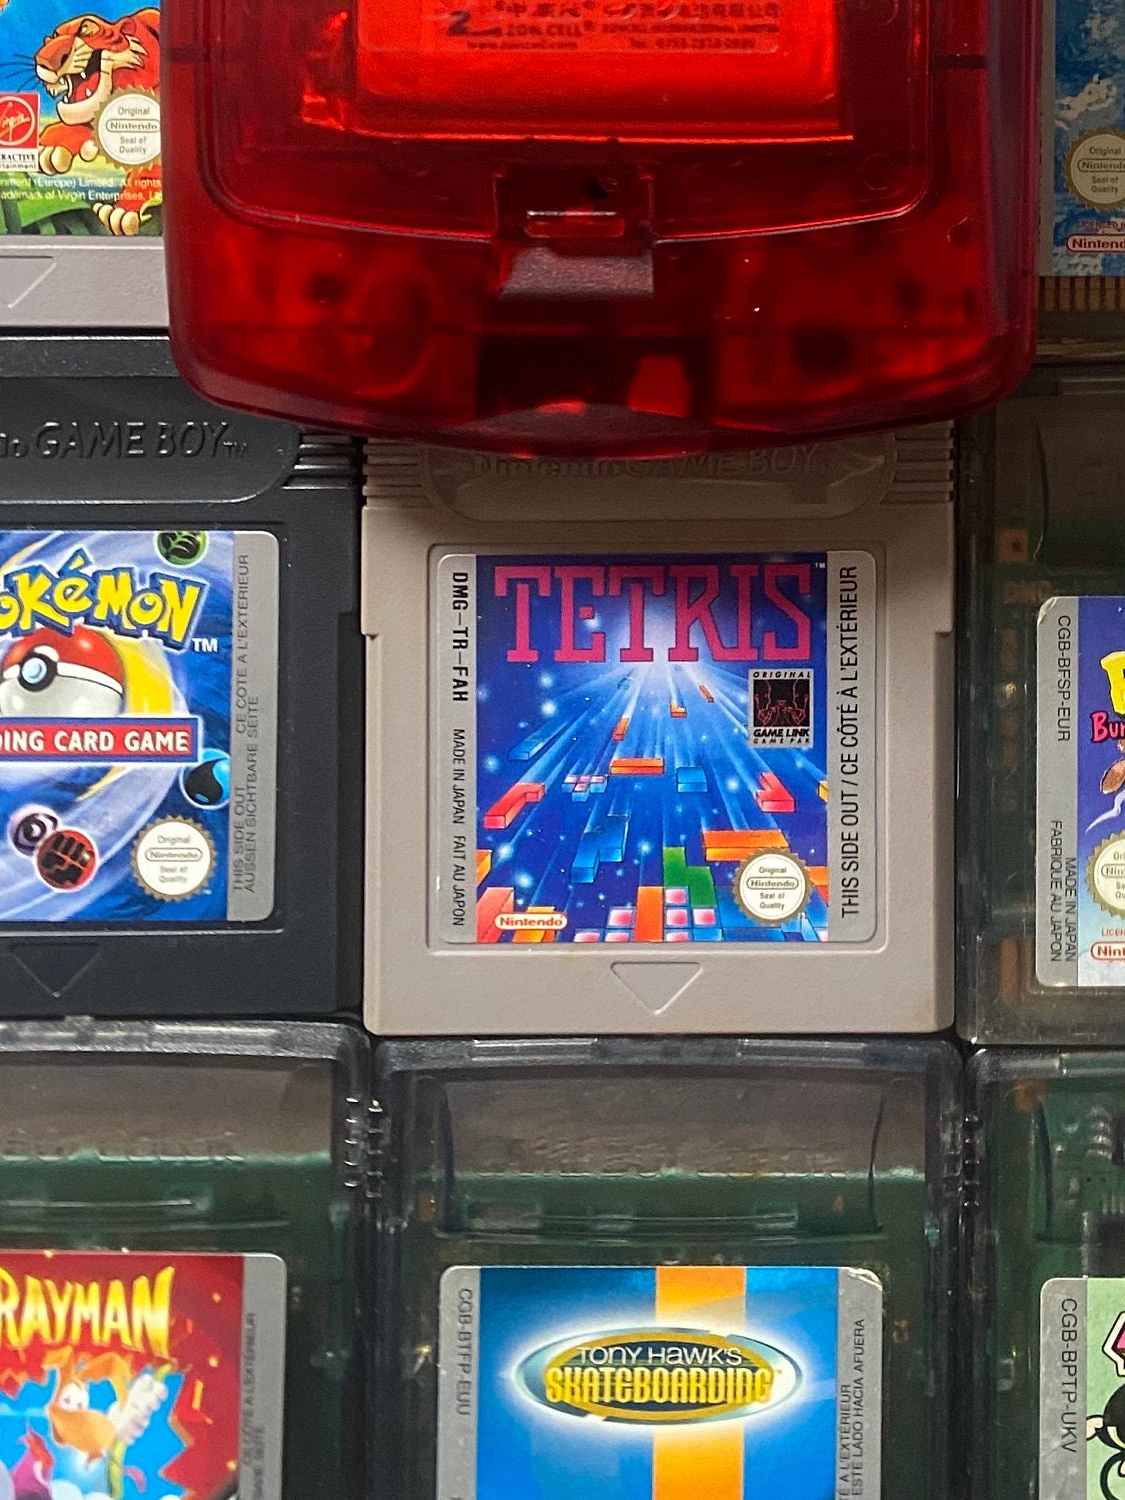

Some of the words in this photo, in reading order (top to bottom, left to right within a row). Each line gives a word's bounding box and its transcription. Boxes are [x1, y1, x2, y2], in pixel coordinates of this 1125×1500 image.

[110, 122, 158, 131] Nintendo
[118, 106, 150, 117] Original
[1089, 146, 1122, 157] Original
[36, 421, 144, 458] GAME
[155, 421, 229, 458] BOY
[494, 565, 812, 663] TETRIS
[839, 565, 859, 682] L'EXTÉRIEUR
[753, 671, 811, 679] ORIGINAL
[1057, 615, 1071, 742] CGB-BFSP-EUR
[54, 730, 114, 752] CARD
[124, 730, 190, 753] GAME
[753, 728, 782, 738] GAME
[783, 728, 811, 738] LINK
[836, 705, 859, 747] CÔTÉ
[453, 728, 466, 765] MADE
[840, 752, 859, 776] CE
[453, 769, 466, 781] IN
[453, 785, 465, 825] JAPAN
[840, 789, 860, 827] OUT
[148, 850, 201, 861] Nintendo
[157, 834, 191, 846] Original
[453, 835, 466, 861] FAIT
[840, 831, 860, 873] SIDE
[1050, 820, 1063, 890] FABRIQUE
[453, 864, 466, 882] AU
[749, 878, 797, 889] Nintendo
[758, 865, 788, 875] Original
[1065, 857, 1077, 897] MADE
[453, 884, 466, 926] JAPON
[840, 875, 860, 920] THIS
[1050, 893, 1062, 913] AU
[1065, 901, 1076, 914] IN
[499, 916, 564, 929] Nintendo
[1050, 916, 1062, 962] JAPON
[1065, 918, 1077, 963] JAPAN
[854, 1318, 865, 1373] AFUERA
[544, 1366, 774, 1405] SKATEBOARDING
[1060, 1298, 1078, 1453] CGB-BPTP-UKV
[853, 1377, 864, 1418] HACIA
[852, 1421, 864, 1457] LADO
[852, 1461, 863, 1496] ESTE
